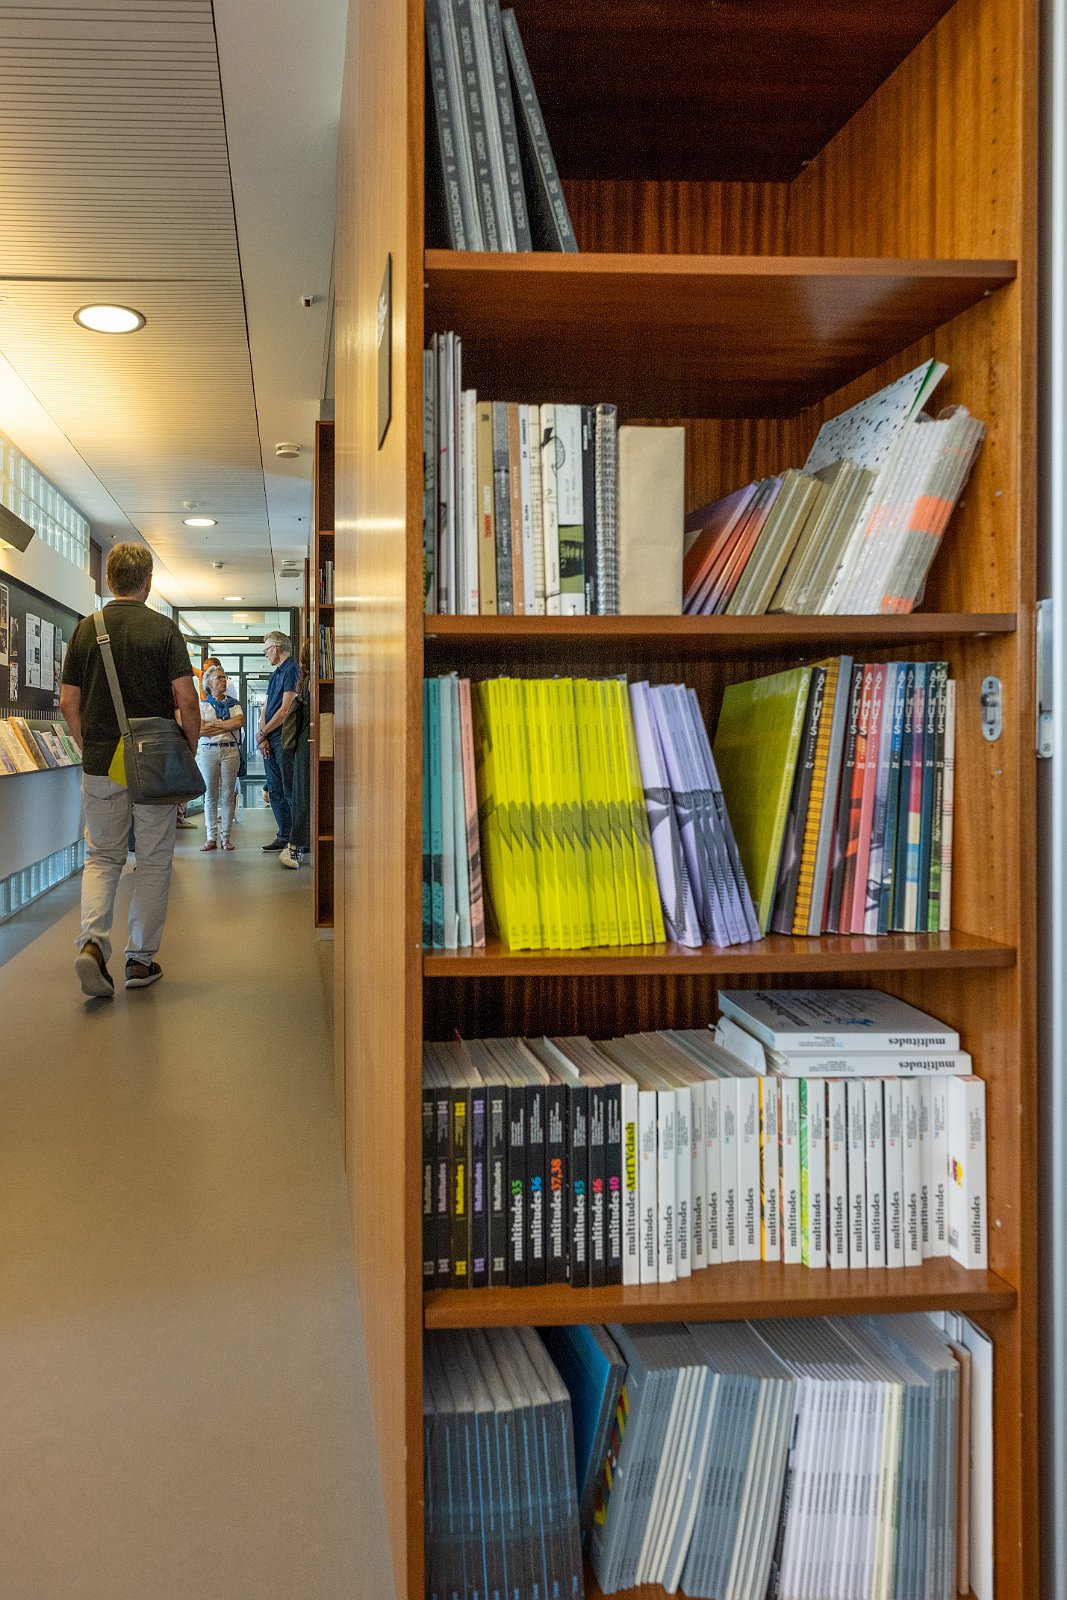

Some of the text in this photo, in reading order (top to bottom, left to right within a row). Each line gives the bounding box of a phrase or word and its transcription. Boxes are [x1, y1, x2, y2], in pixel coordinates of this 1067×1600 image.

[810, 671, 825, 736] AZIMUTS
[850, 671, 863, 734] AZIMUTS
[859, 672, 872, 736] AZIMUTS
[870, 671, 882, 735] AZIMUTS
[894, 671, 905, 734] AZIMUTS
[905, 670, 915, 733] AZIMUTS
[927, 670, 937, 734] AZIMUTS
[937, 670, 947, 734] AZIMUTS
[888, 1037, 946, 1047] multitudes
[899, 1060, 955, 1071] multitudes
[493, 1161, 502, 1211] Multitudes
[920, 1185, 928, 1242] multitudes
[936, 1184, 944, 1240] multitudes
[511, 1180, 524, 1261] multitudes35
[531, 1176, 543, 1258] multitudes36
[645, 1207, 653, 1266] multitudes
[664, 1205, 673, 1264] multitudes
[679, 1201, 687, 1259] multitudes
[694, 1196, 702, 1255] multitudes
[709, 1192, 718, 1249] multitudes
[726, 1189, 734, 1246] multitudes
[745, 1188, 754, 1244] multitudes
[768, 1189, 776, 1246] multitudes
[788, 1190, 796, 1246] multitudes
[813, 1193, 821, 1251] multitudes
[835, 1196, 843, 1254] multitudes
[854, 1194, 863, 1252] multitudes
[872, 1193, 881, 1251] multitudes
[891, 1192, 900, 1249] multitudes
[908, 1193, 917, 1251] multitudes
[971, 1196, 981, 1254] multitudes
